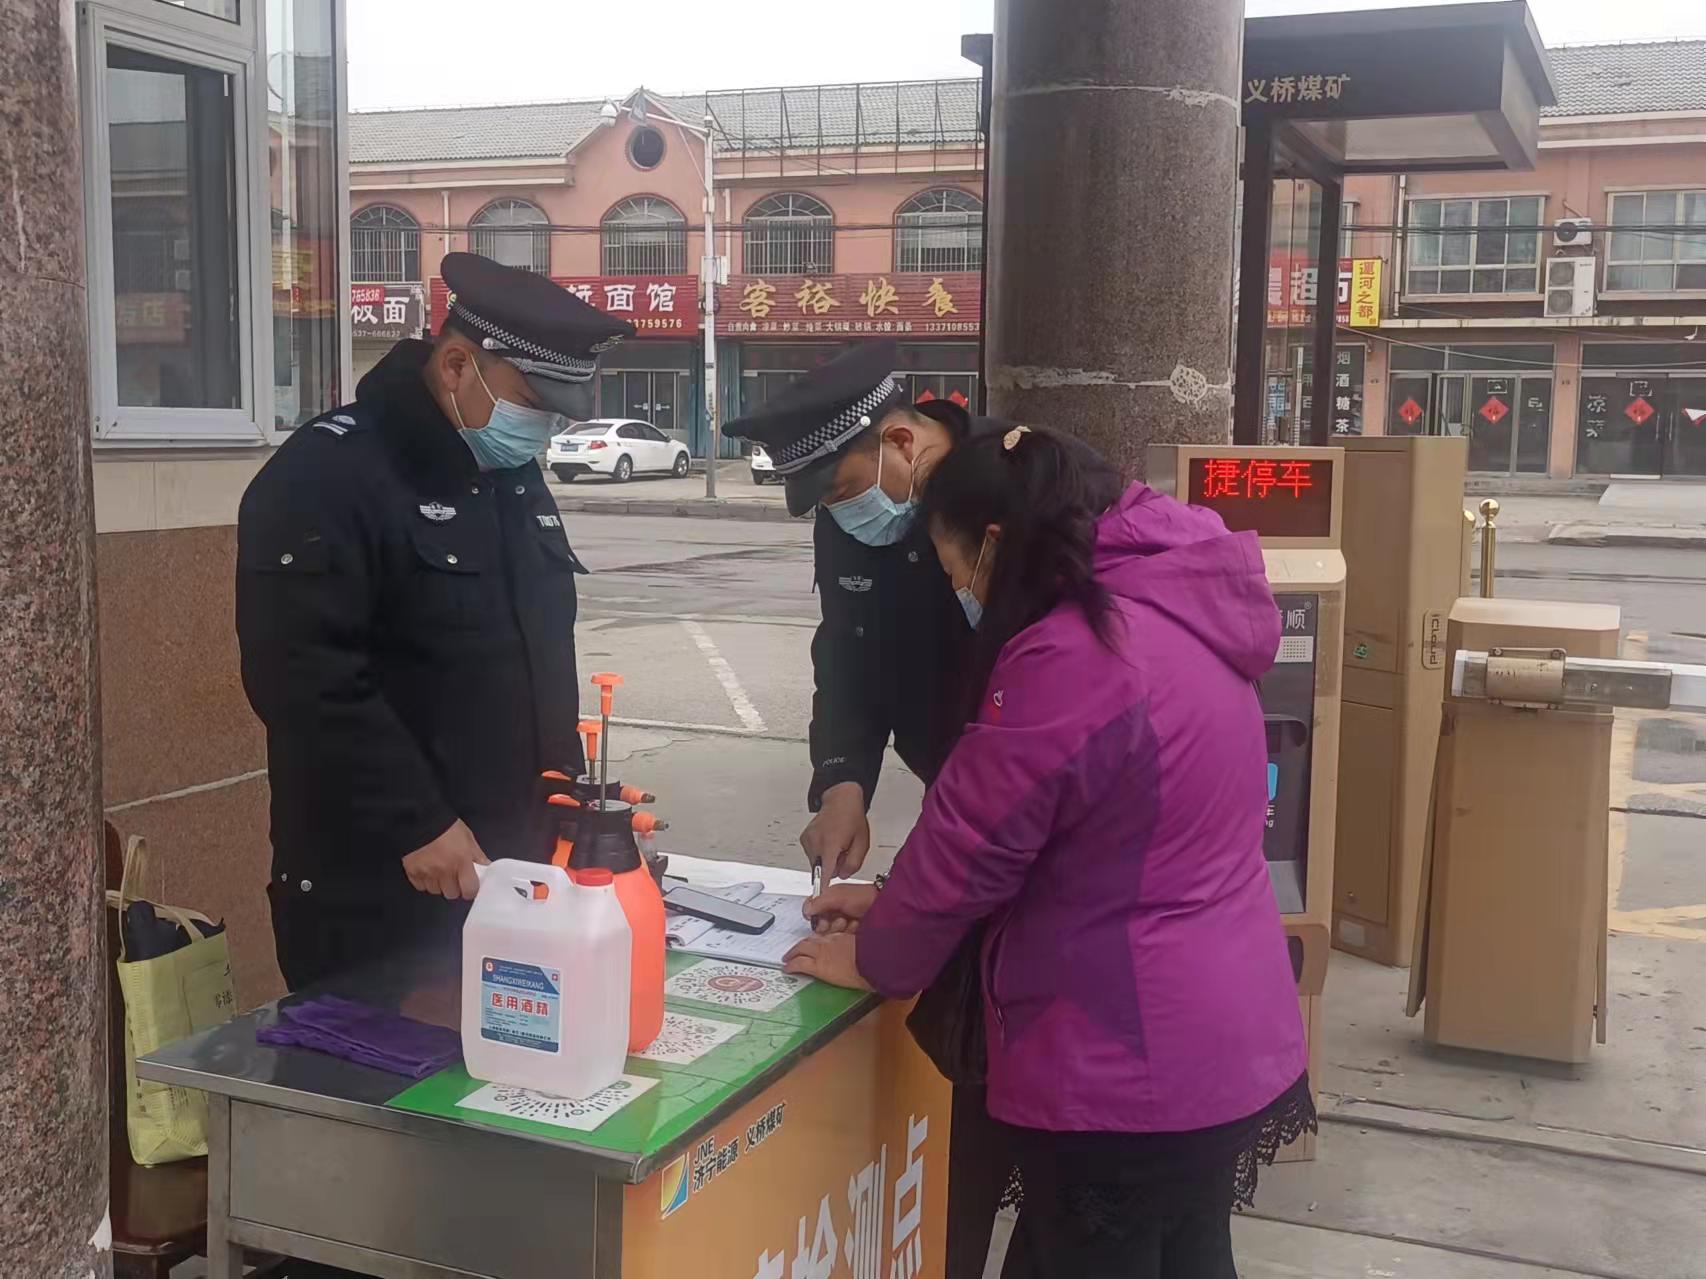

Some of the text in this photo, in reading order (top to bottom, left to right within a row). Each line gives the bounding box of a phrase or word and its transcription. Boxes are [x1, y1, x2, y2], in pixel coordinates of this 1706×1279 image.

[1244, 73, 1351, 104] 义桥煤矿
[627, 318, 683, 329] 3759576
[1335, 351, 1351, 433] 烟酒糖茶
[1203, 459, 1313, 499] 捷停车
[491, 991, 549, 1017] 医用酒精
[692, 1100, 787, 1194] 济宁能源 义桥煤矿
[694, 1136, 716, 1167] JNE
